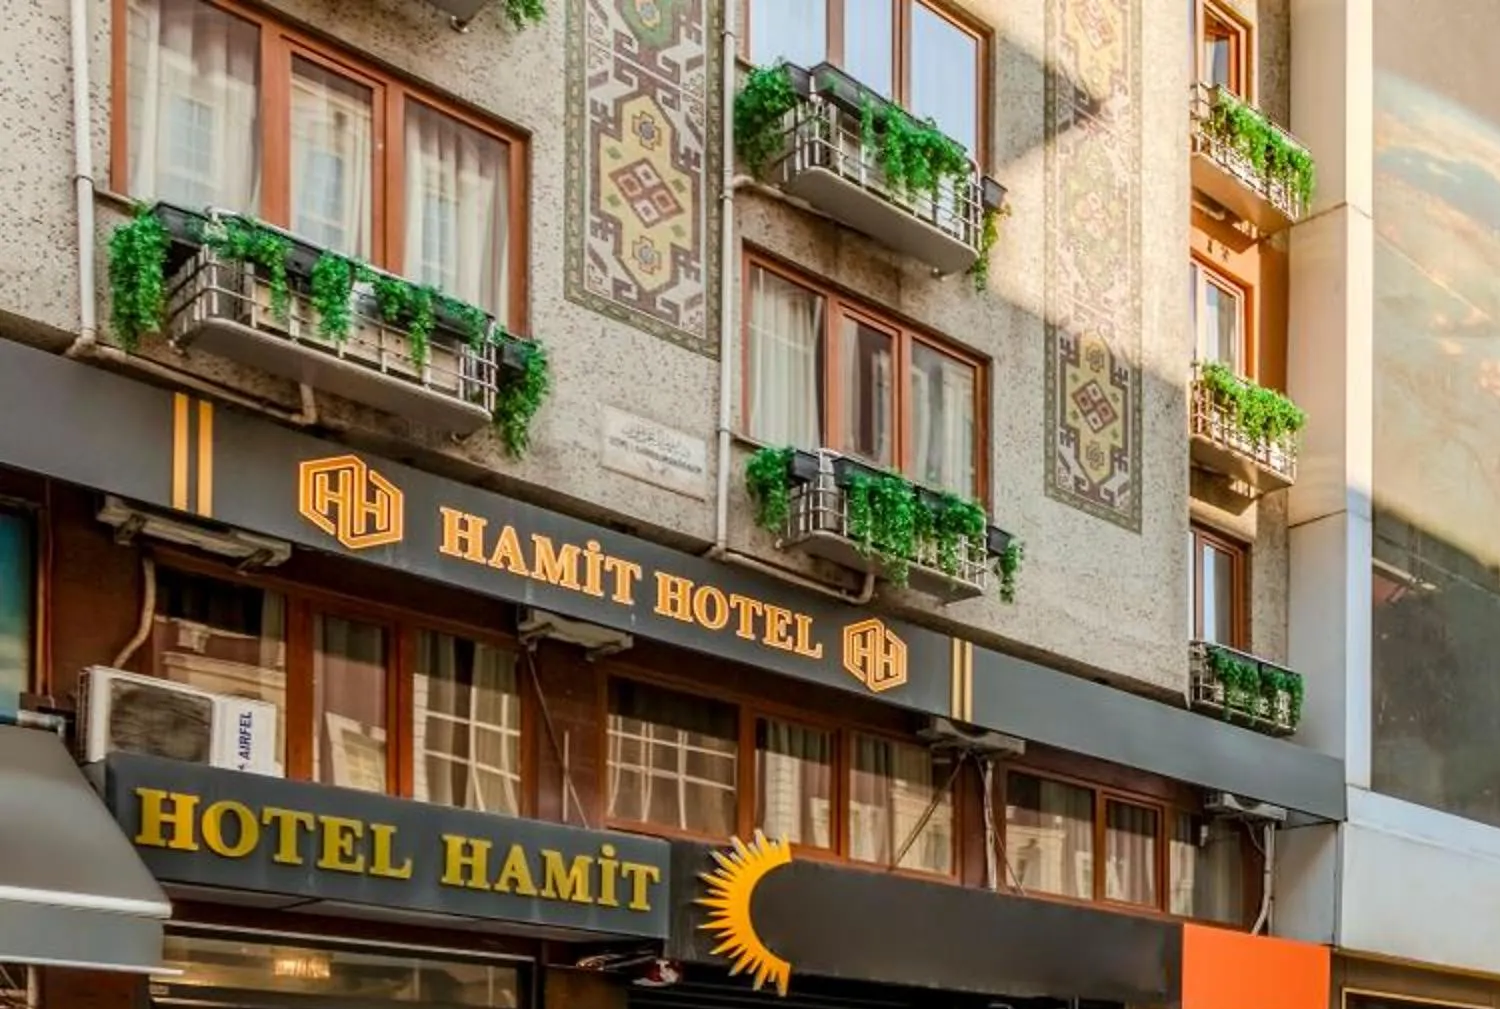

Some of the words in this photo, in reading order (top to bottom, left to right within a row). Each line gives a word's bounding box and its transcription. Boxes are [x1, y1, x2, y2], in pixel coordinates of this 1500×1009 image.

[439, 506, 643, 605] HAMİT
[653, 570, 823, 660] HOTEL
[238, 711, 252, 760] AIRFEL
[134, 786, 412, 880] HOTEL
[440, 834, 661, 911] HAMİT
